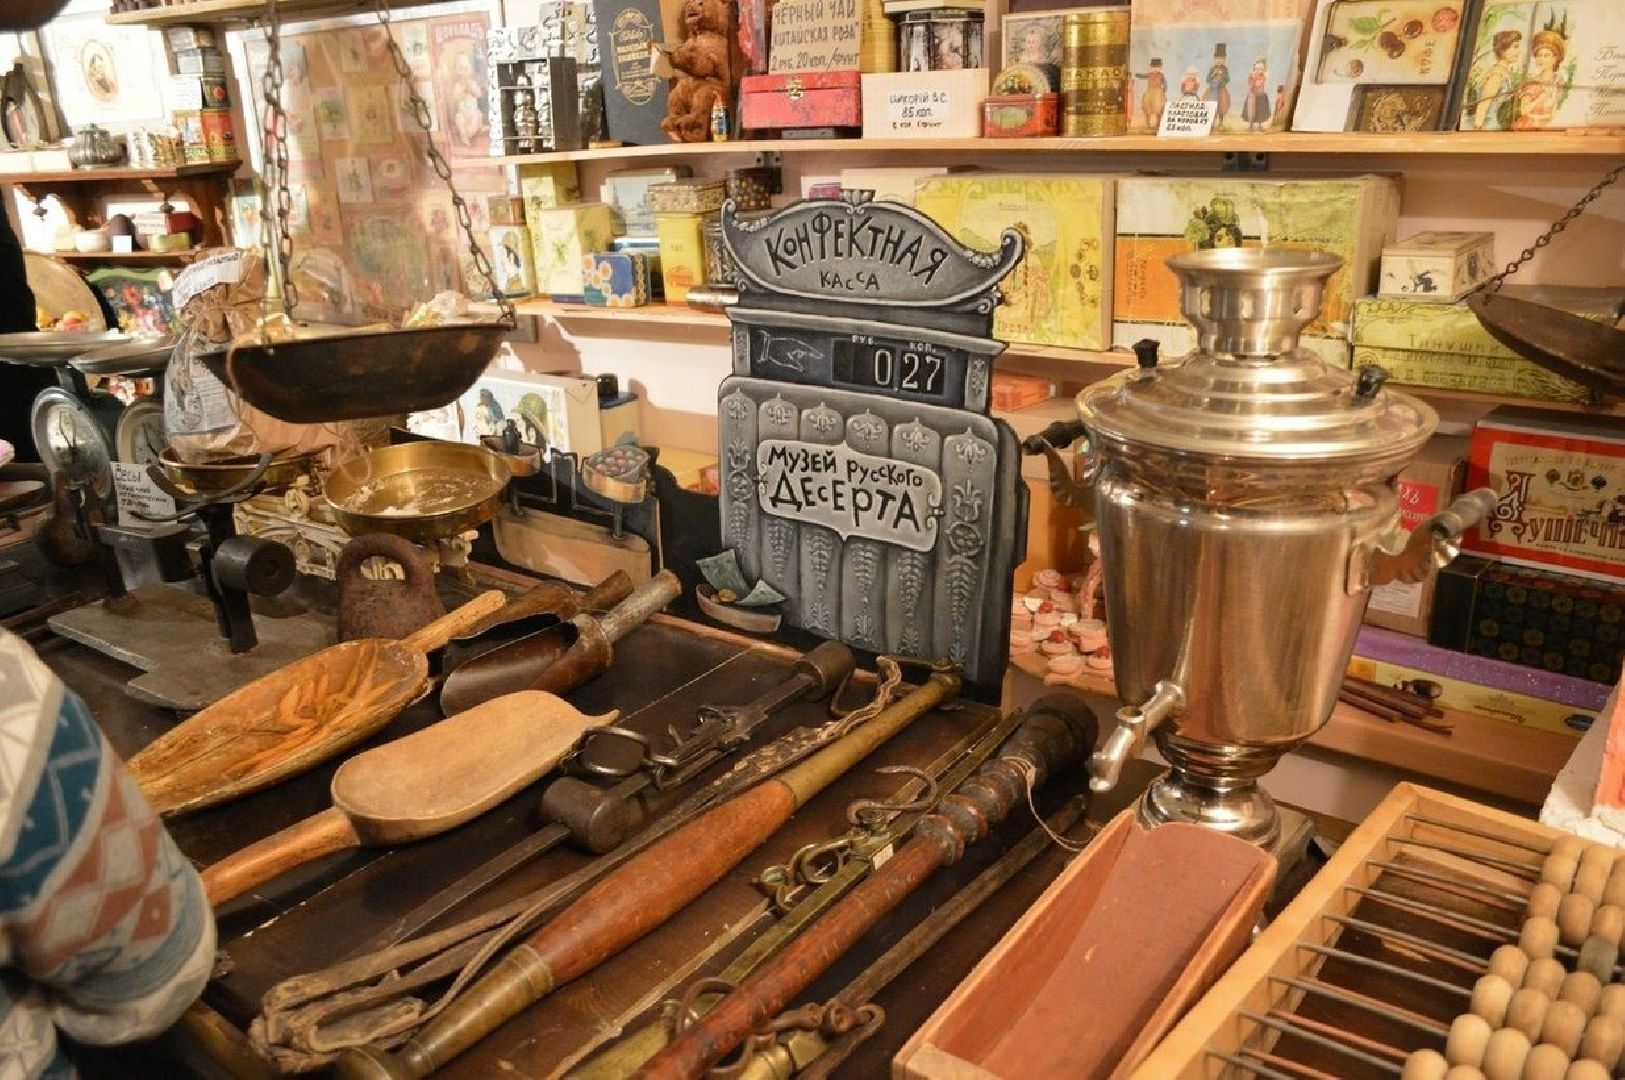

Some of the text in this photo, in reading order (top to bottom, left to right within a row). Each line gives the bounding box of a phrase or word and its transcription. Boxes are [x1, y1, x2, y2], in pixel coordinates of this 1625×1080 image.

[765, 211, 948, 286] КОНФЕКТНАЯ
[819, 270, 880, 291] КАССА
[768, 446, 923, 487] МУЗЕЙ РУССКОГО
[768, 469, 921, 532] ДЕСЕРТА
